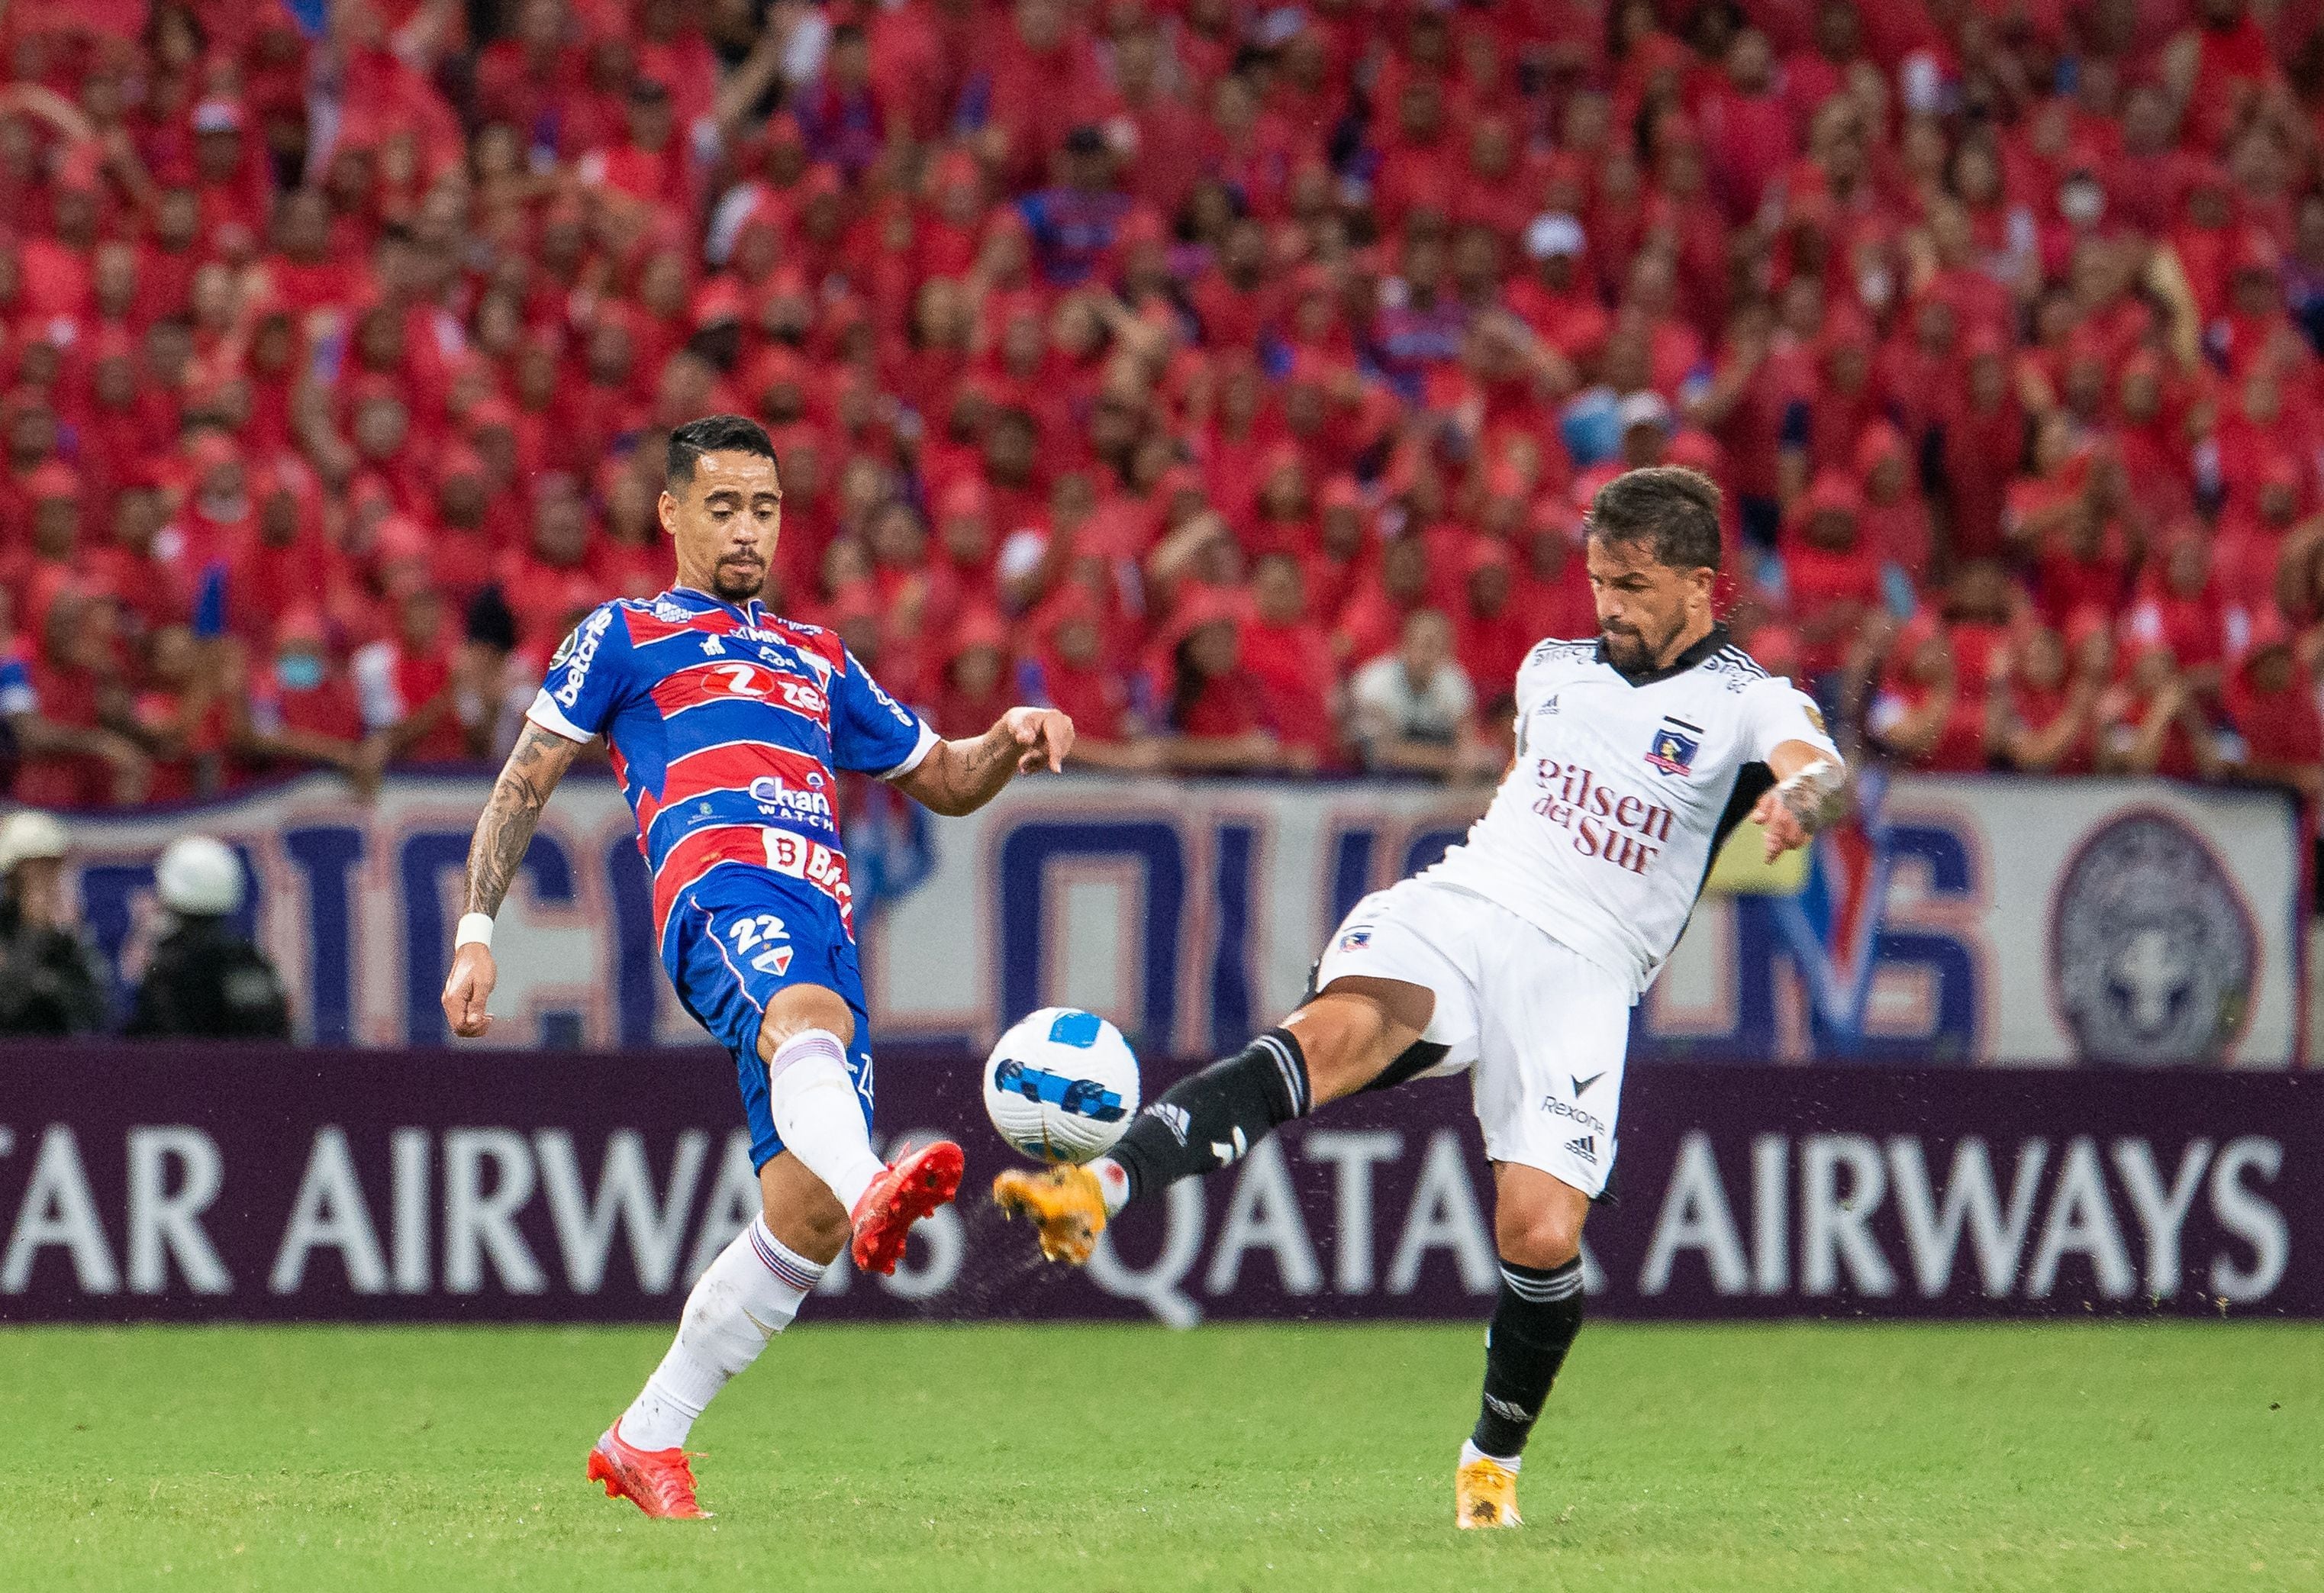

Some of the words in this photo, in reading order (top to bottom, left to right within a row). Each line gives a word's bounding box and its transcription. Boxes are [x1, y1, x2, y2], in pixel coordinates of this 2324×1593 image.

[555, 607, 614, 708] betcris
[757, 805, 834, 833] WATCH
[1536, 758, 1674, 843] Pilsen
[1572, 815, 1660, 877] Sur
[729, 914, 791, 956] 22
[0, 1122, 235, 1296] AR
[1636, 1127, 2291, 1304] AIRWAYS
